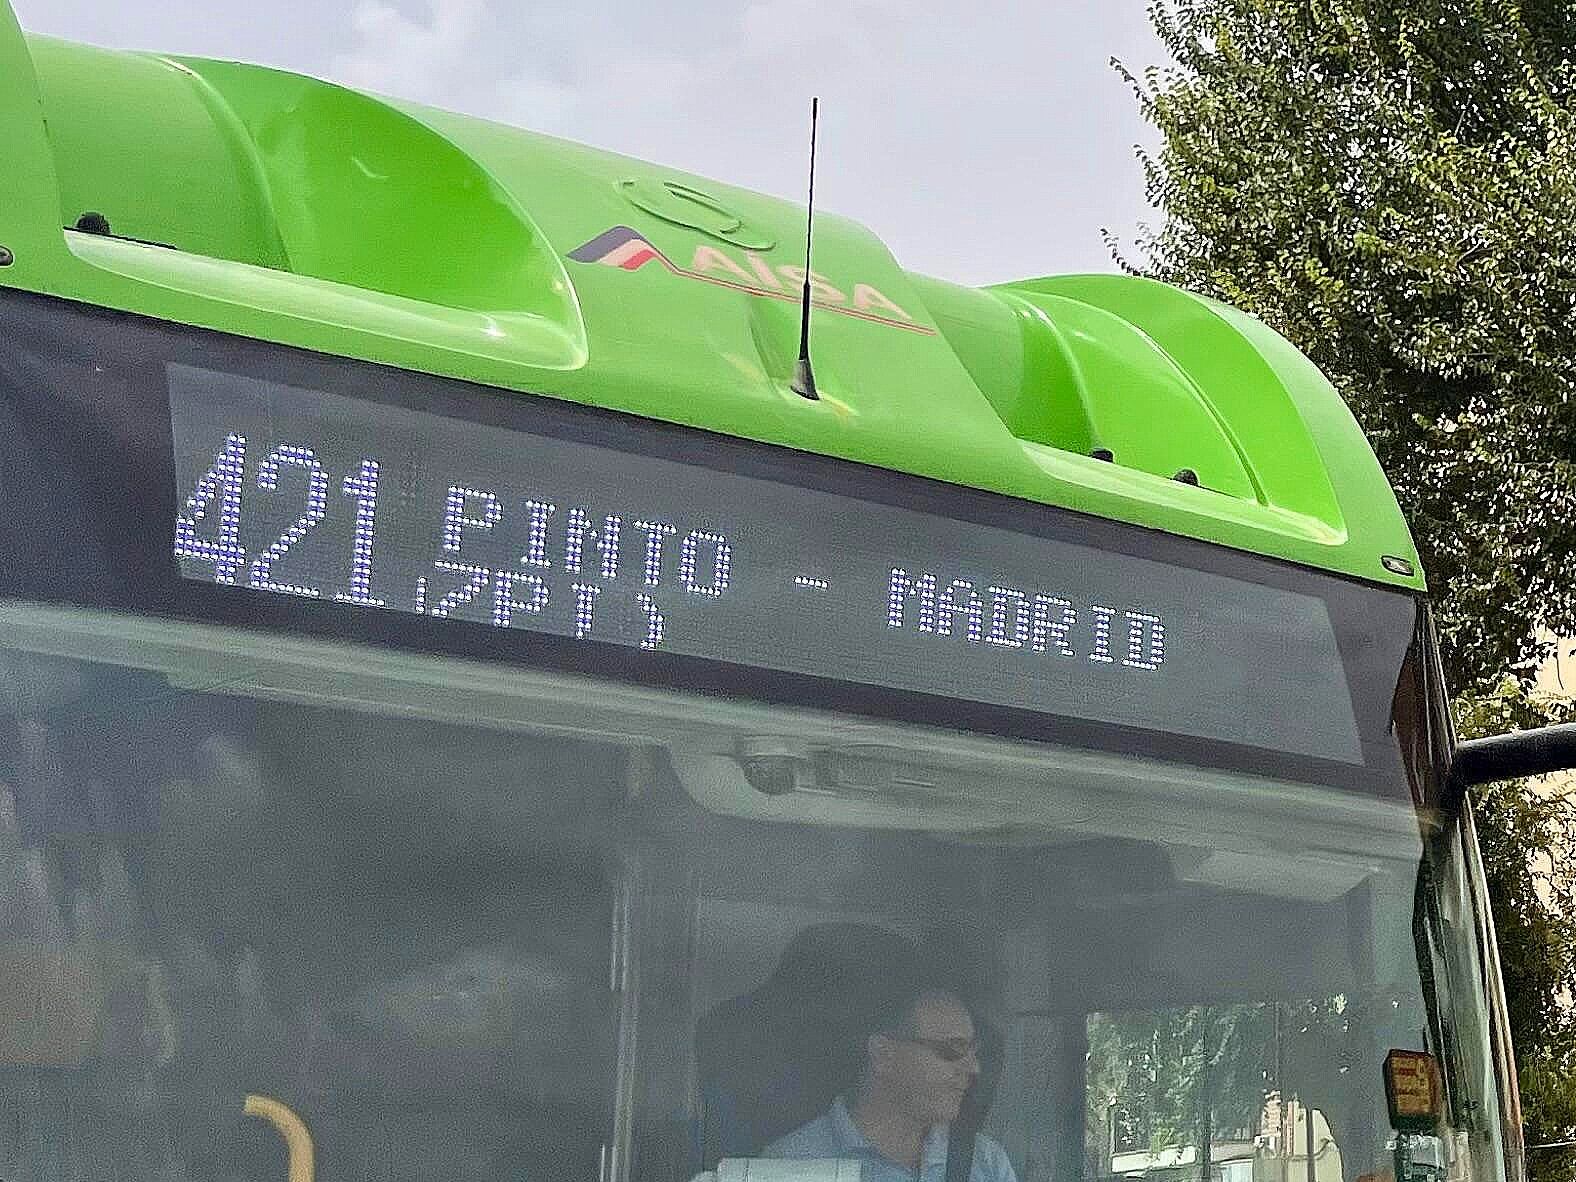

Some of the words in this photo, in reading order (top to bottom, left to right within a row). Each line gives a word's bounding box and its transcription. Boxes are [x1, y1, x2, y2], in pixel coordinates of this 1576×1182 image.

[174, 432, 386, 607] 421
[443, 486, 733, 600] PINTO
[887, 567, 1166, 671] MADRID
